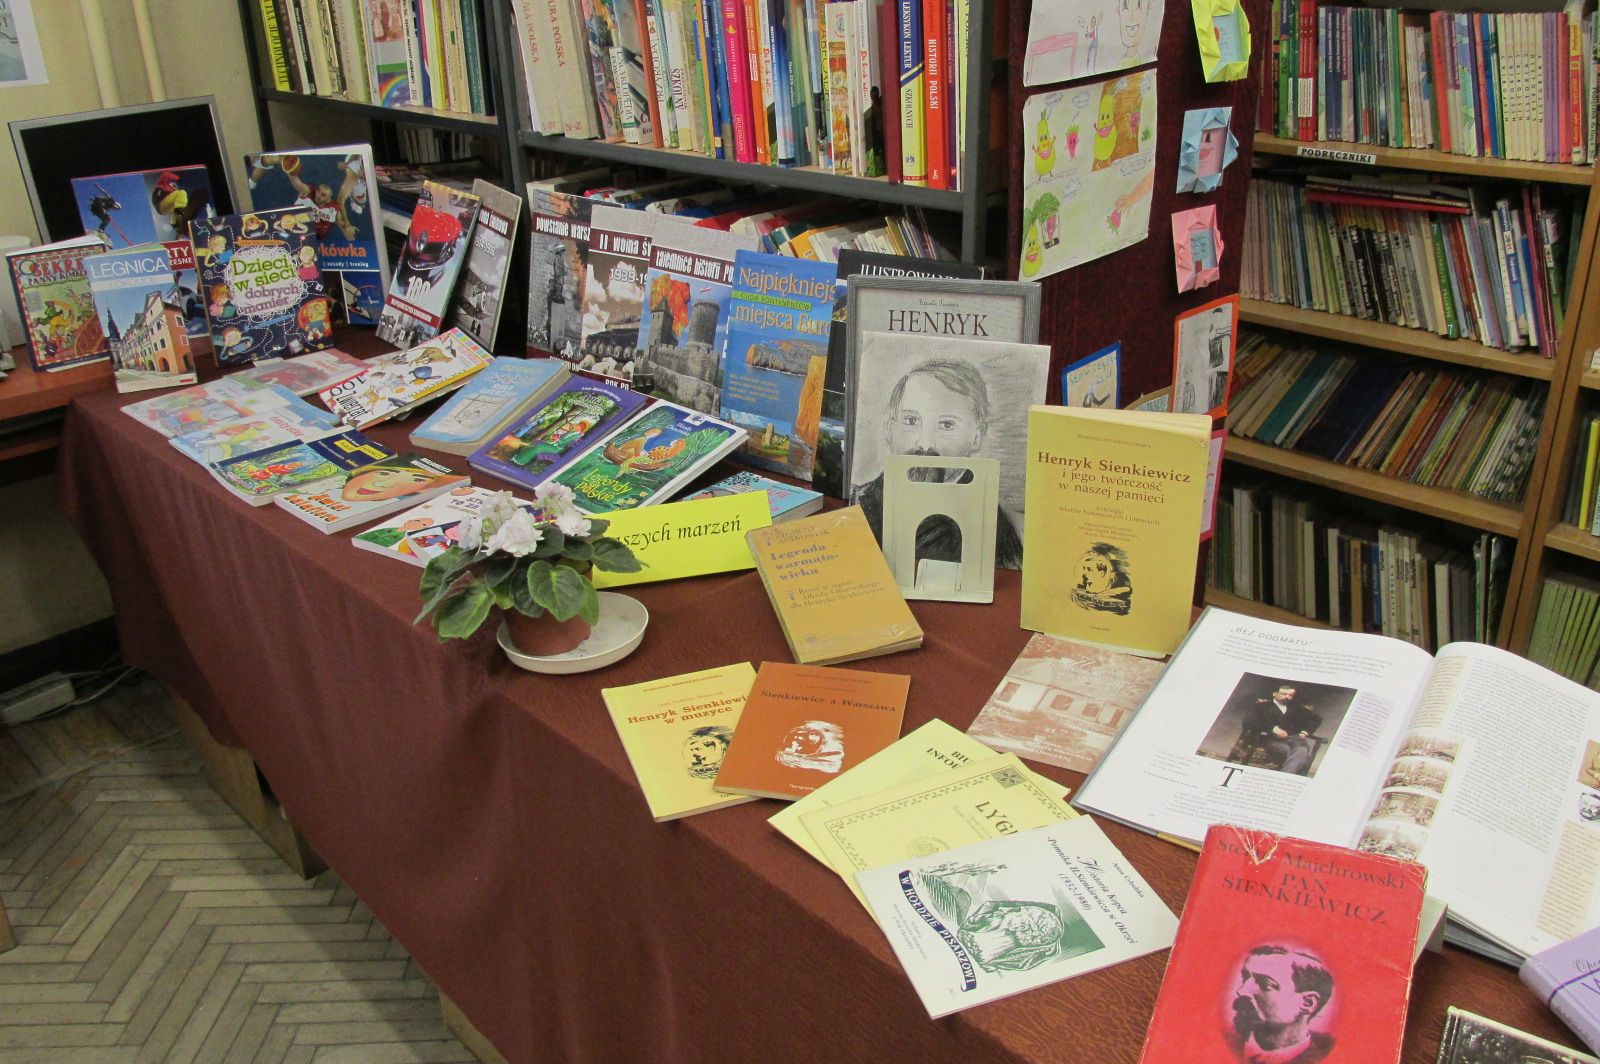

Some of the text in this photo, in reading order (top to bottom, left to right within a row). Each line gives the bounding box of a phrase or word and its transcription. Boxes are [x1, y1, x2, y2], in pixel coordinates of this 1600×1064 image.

[903, 1, 913, 129] LEKSYKON LEKTUR SZKOLNYCH
[928, 39, 939, 109] HISTORII POLSKI
[669, 68, 684, 110] SZKOLNY
[1301, 147, 1372, 163] PODRĘCZNIKI
[320, 243, 368, 258] kówka
[599, 233, 609, 251] II
[34, 258, 86, 277] SEKRE
[89, 257, 169, 279] LEGNICA
[168, 257, 194, 266] ZESNE
[232, 254, 290, 277] Dzieci
[234, 266, 297, 293] w sieci
[244, 282, 300, 300] dobrych
[406, 275, 432, 301] 100
[738, 266, 837, 304] Najpiękniejs
[243, 295, 291, 316] manier
[734, 302, 832, 336] miejsca Euro
[887, 309, 989, 337] HENRYK
[1037, 451, 1192, 484] Henryk Sienkiewicz
[1070, 468, 1097, 485] jego
[1100, 472, 1164, 493] twórczość
[1057, 481, 1165, 506] w naszej pamięci
[615, 514, 742, 552] szych marzeń
[627, 706, 679, 726] Henryk
[682, 694, 751, 715] Sienkiewi
[760, 688, 826, 706] Sienkiewicz
[841, 699, 898, 714] Warszawa
[664, 715, 676, 726] w
[951, 749, 974, 767] BIU
[973, 799, 1019, 836] LYG
[1280, 872, 1331, 896] PAN
[1281, 851, 1406, 891] Majchrowski
[1107, 893, 1128, 916] Kopca
[1221, 874, 1389, 927] SIENKIEWICZ
[899, 875, 911, 886] W
[938, 928, 977, 984] PISARZOWI
